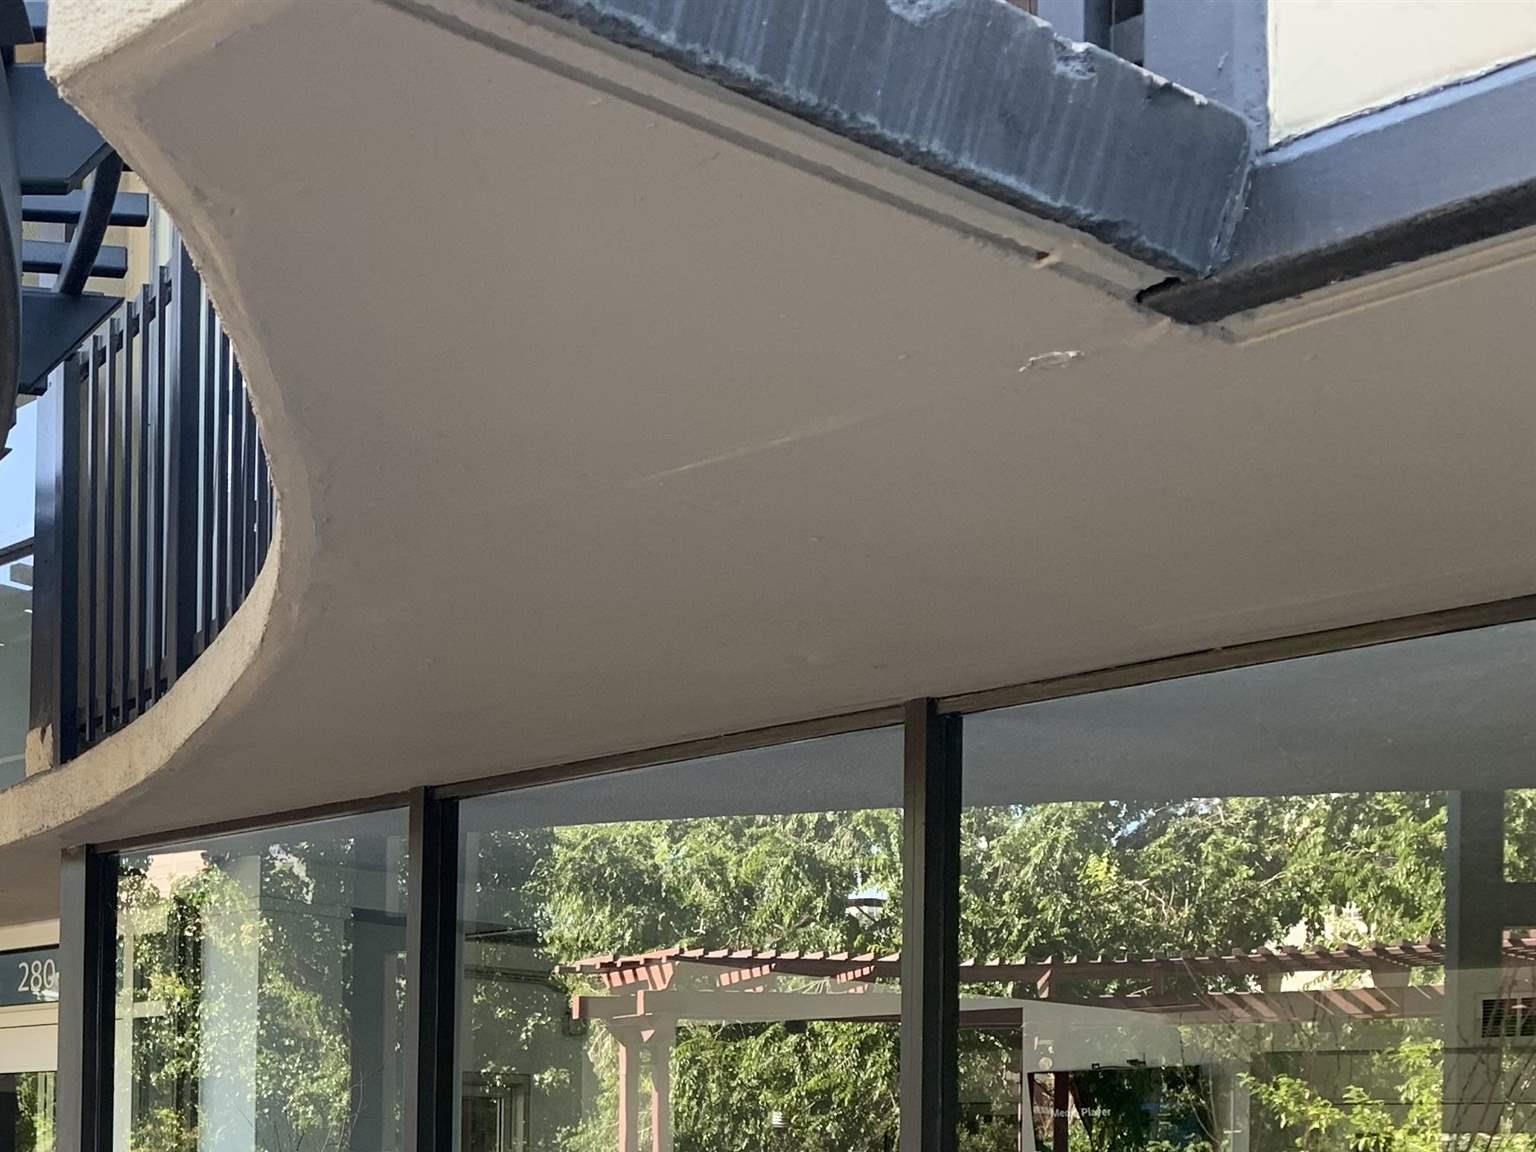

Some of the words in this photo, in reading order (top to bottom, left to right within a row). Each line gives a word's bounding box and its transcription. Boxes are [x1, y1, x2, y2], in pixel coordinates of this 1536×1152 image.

[17, 958, 57, 992] 280
[1051, 1108, 1079, 1118] Med
[1081, 1107, 1111, 1118] Player
